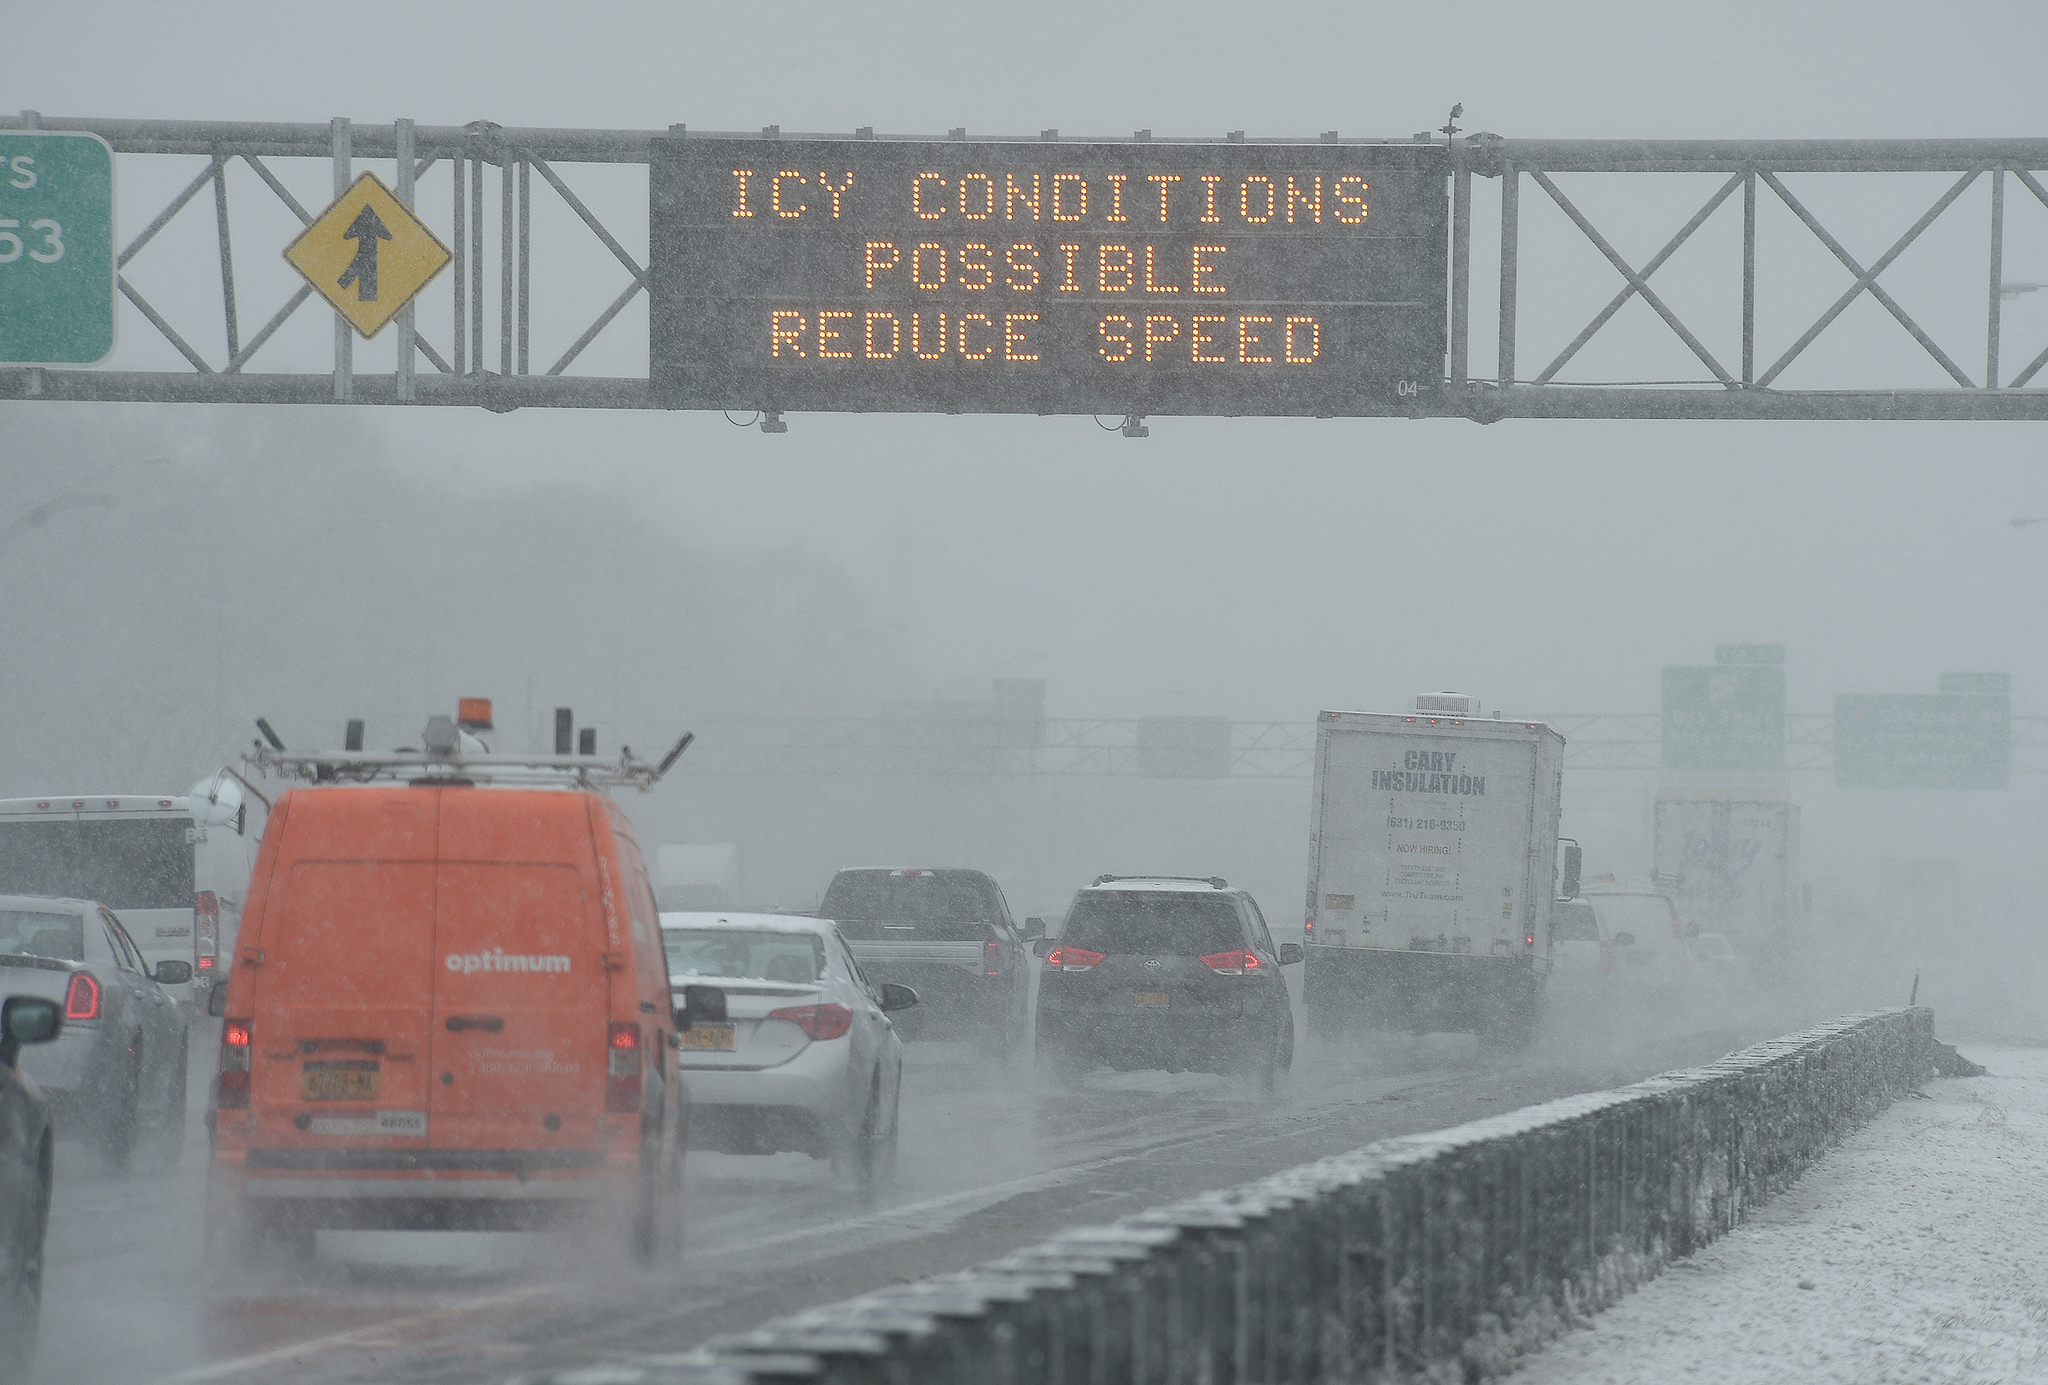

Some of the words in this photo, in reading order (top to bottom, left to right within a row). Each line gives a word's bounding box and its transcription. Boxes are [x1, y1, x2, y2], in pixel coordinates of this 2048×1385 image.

[0, 155, 38, 189] S
[732, 168, 855, 220] ICY
[911, 172, 1371, 226] CONDITIONS
[0, 219, 66, 263] 53
[865, 240, 1229, 295] POSSIBLE
[770, 309, 1040, 362] REDUCE
[1097, 313, 1322, 365] SPEED
[1404, 750, 1456, 772] CARY
[1372, 770, 1485, 796] INSULATION
[1396, 844, 1418, 854] NOW
[1419, 845, 1452, 856] HIRING!
[445, 946, 572, 976] optimum
